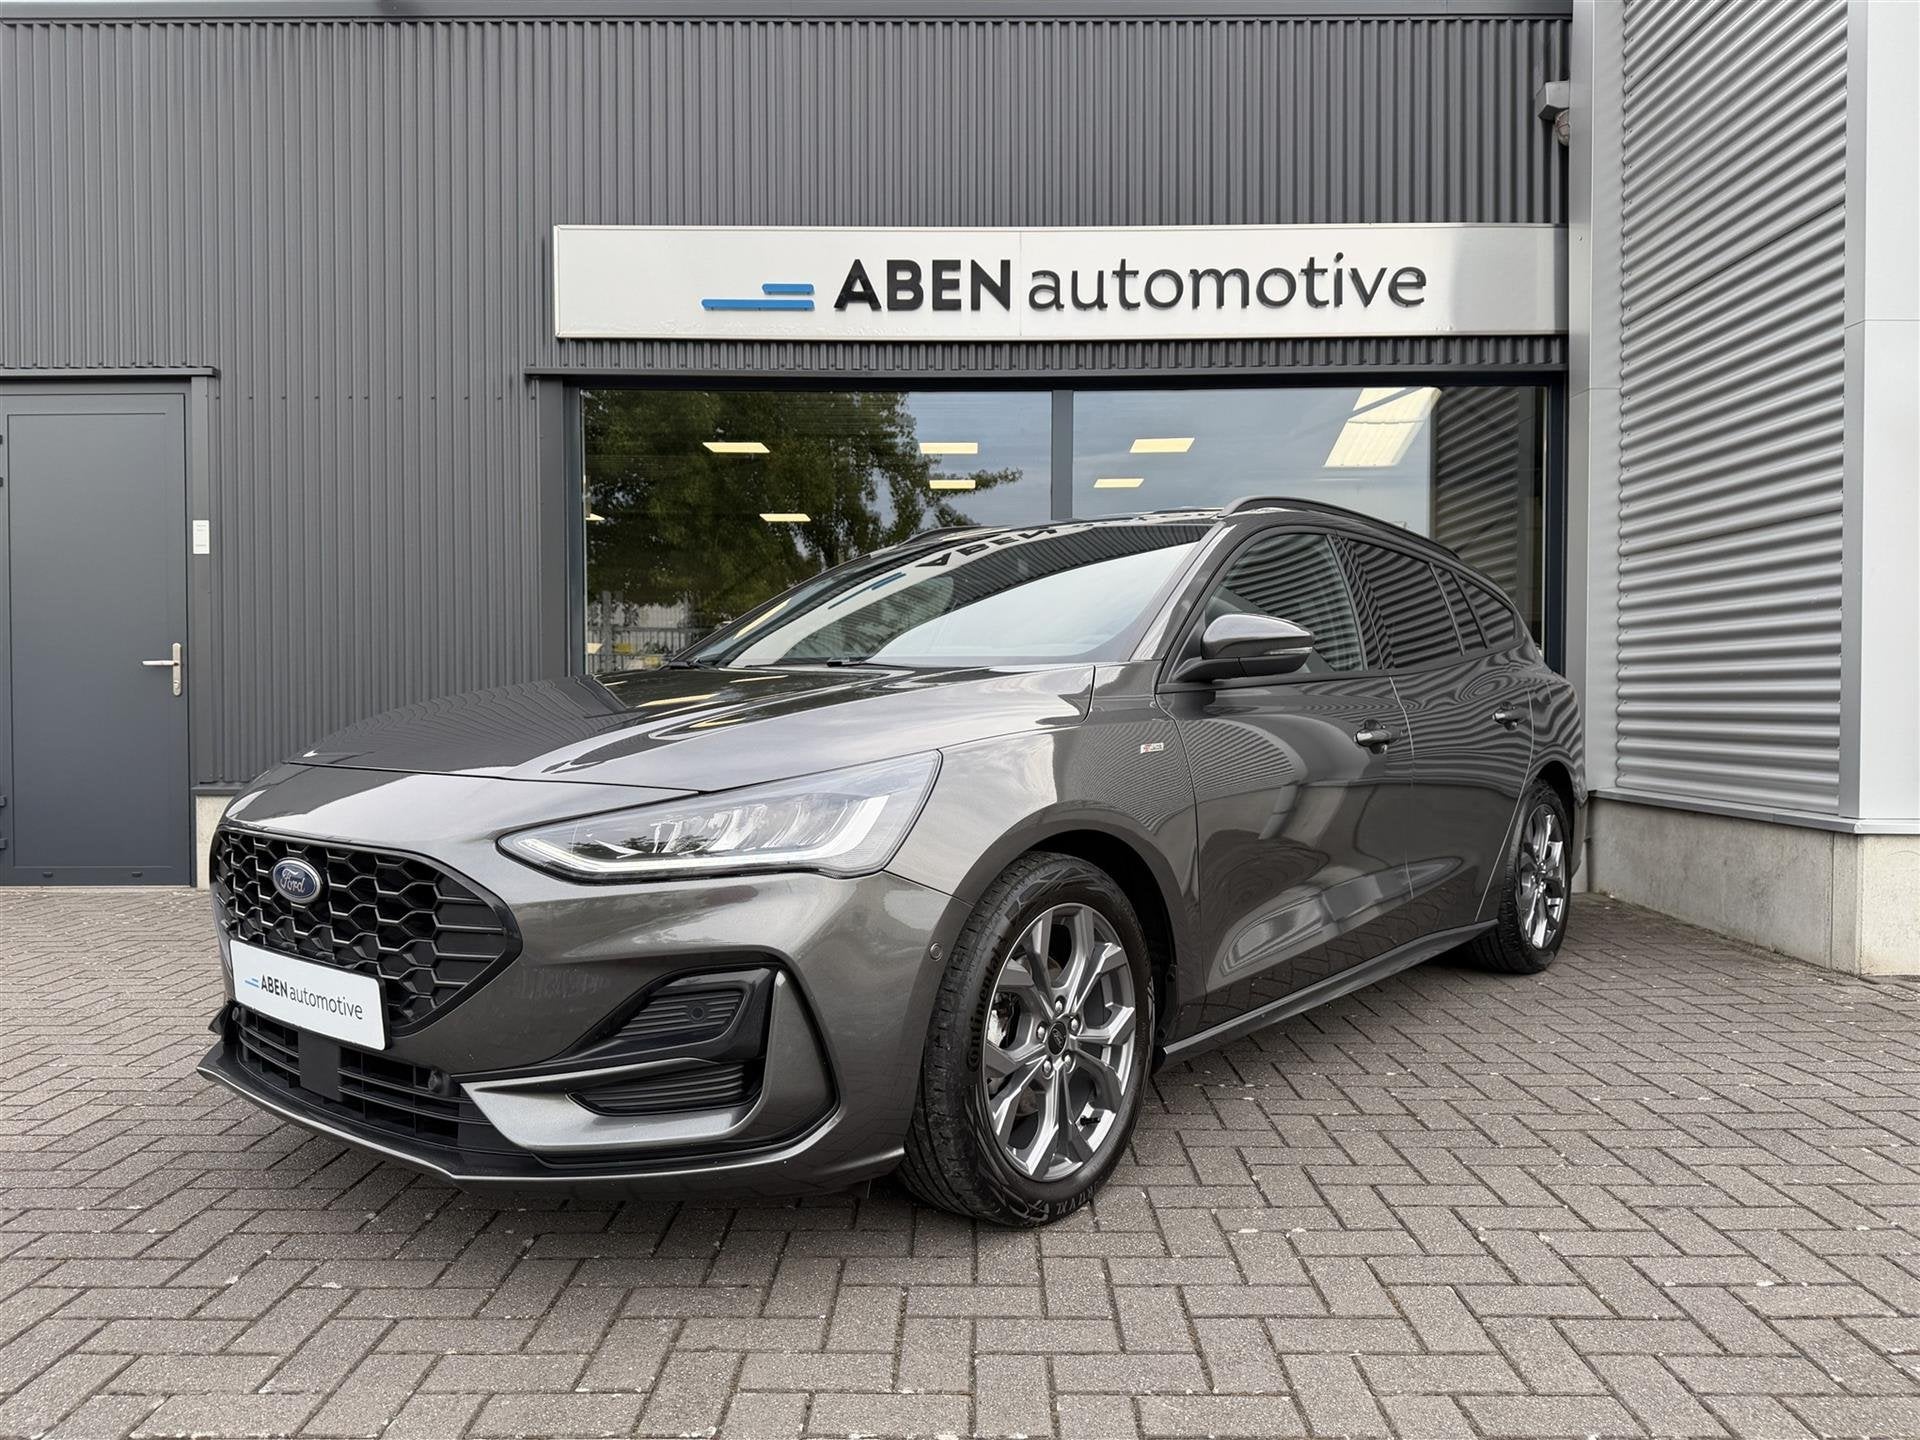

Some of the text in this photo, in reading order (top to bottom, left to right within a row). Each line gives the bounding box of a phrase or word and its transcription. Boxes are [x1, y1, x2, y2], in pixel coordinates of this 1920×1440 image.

[834, 253, 1427, 312] ABEN automotive
[280, 868, 306, 893] Ford
[260, 974, 363, 1020] ABEN automotive
